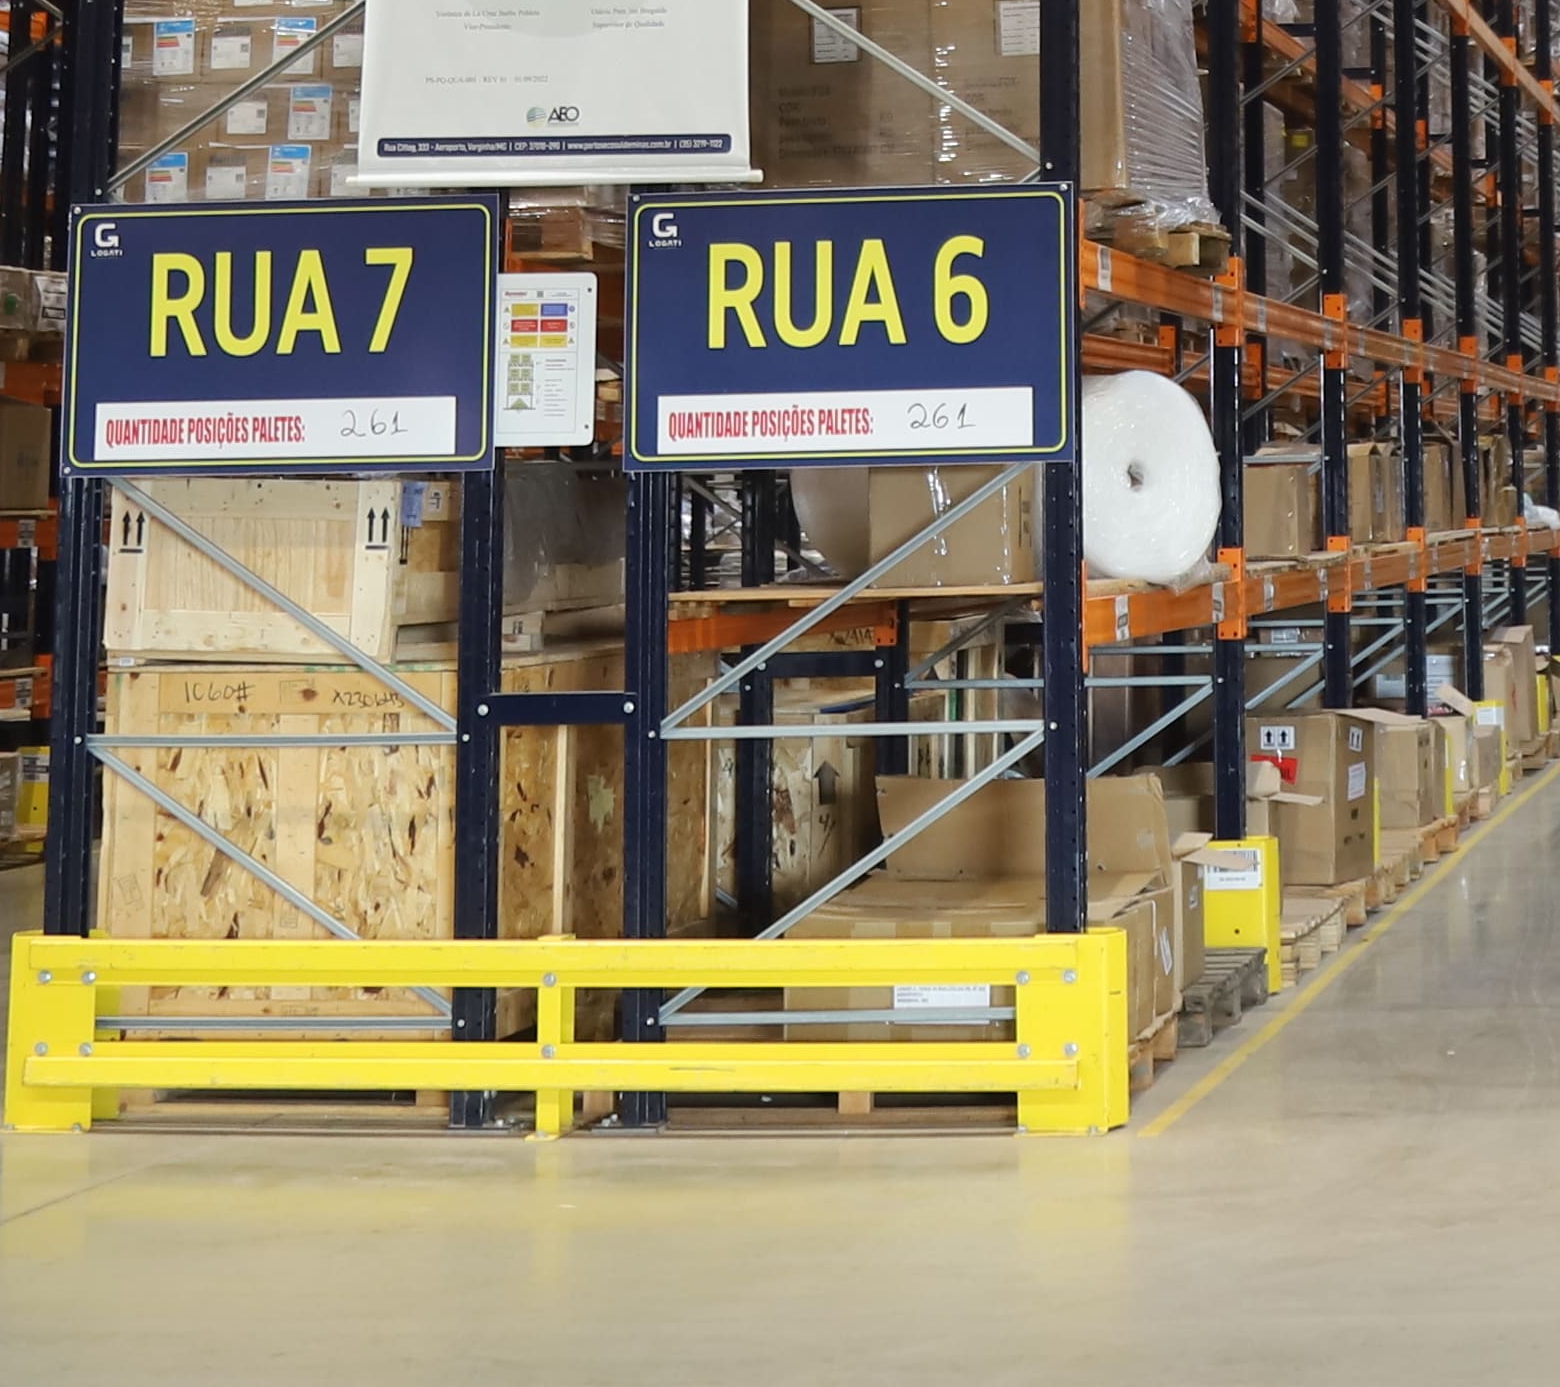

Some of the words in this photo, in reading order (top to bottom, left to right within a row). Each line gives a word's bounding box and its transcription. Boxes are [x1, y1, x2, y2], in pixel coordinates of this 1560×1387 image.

[547, 106, 580, 122] AEO
[95, 223, 119, 248] G
[652, 213, 678, 238] G
[90, 249, 123, 257] LOGATI
[649, 239, 682, 248] LOGATI
[149, 249, 342, 358] RUA
[365, 247, 413, 353] 7
[708, 239, 907, 349] RUA
[933, 235, 990, 345] 6
[106, 417, 185, 448] QUANTIDADE
[188, 412, 249, 448] POSIÇÕES
[252, 415, 305, 444] PALETES:
[340, 409, 408, 437] 261
[668, 410, 749, 442] QUANTIDADE
[751, 405, 815, 442] POSIÇÕES
[818, 407, 874, 436] PALETES:
[907, 402, 976, 430] 261
